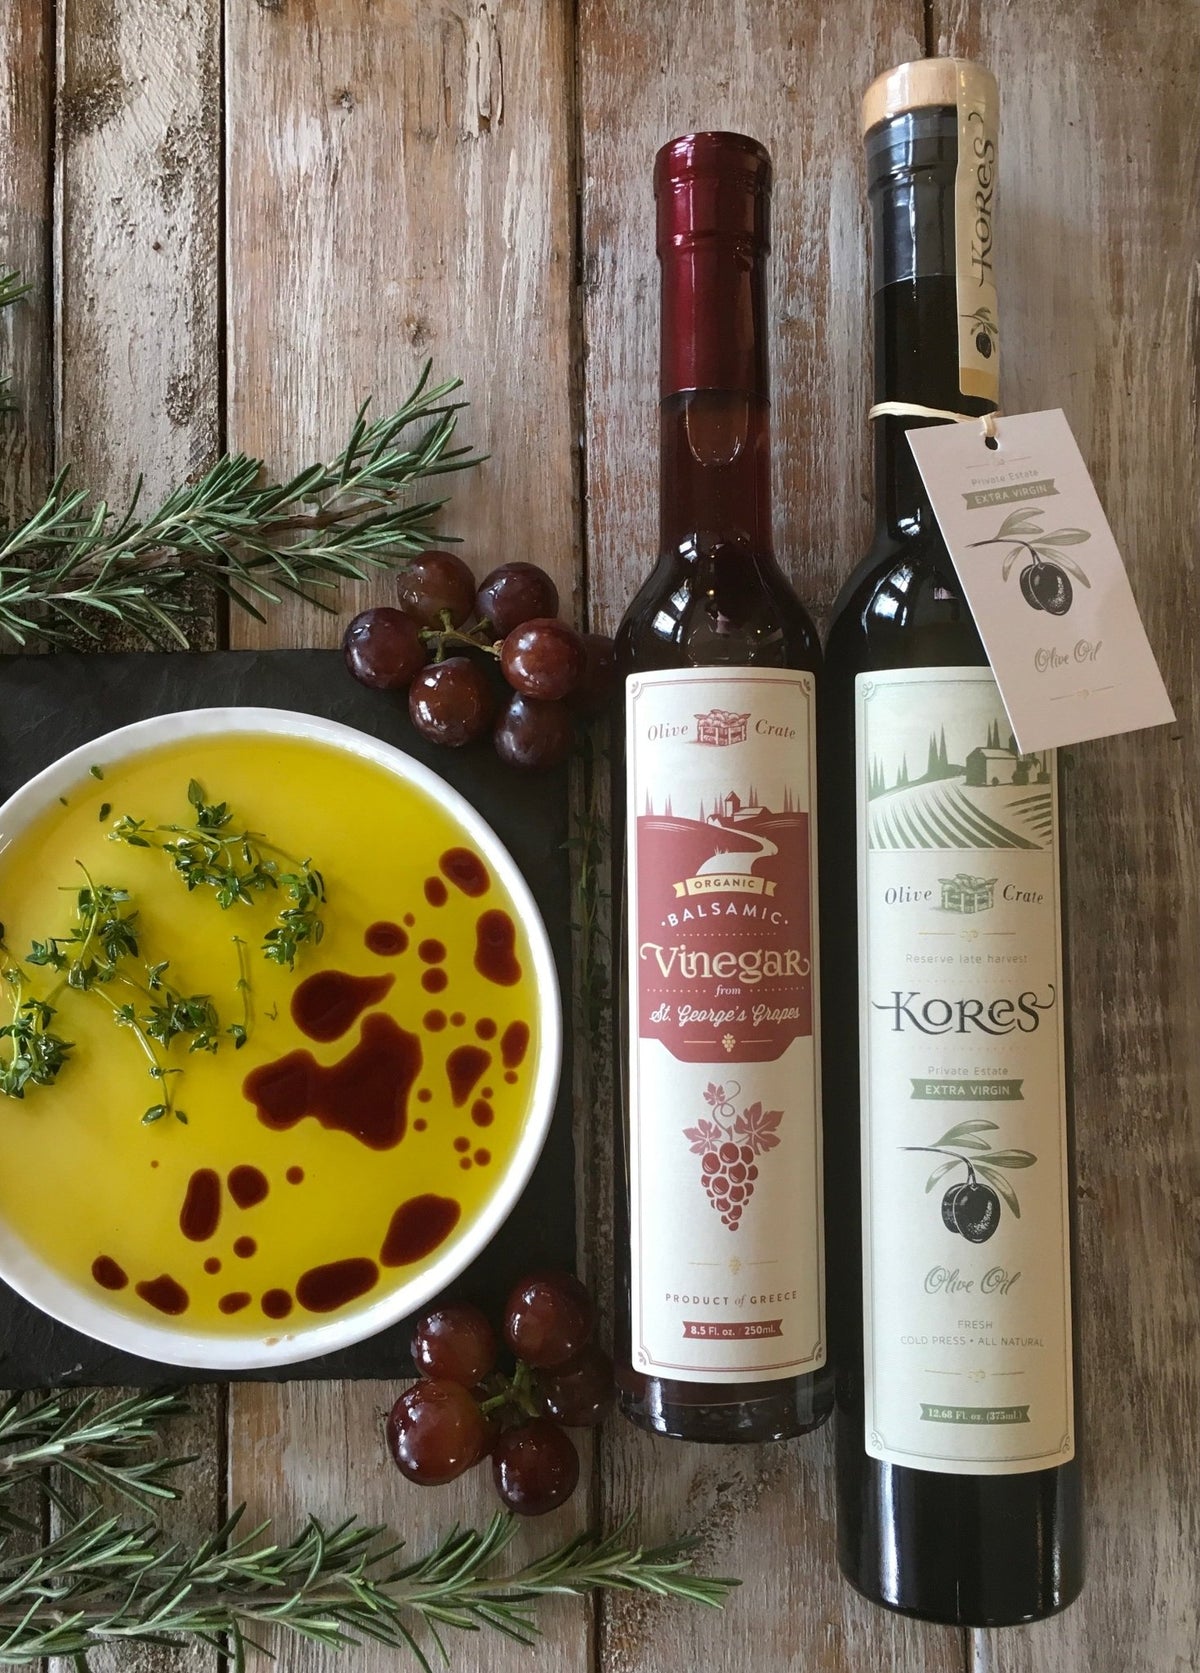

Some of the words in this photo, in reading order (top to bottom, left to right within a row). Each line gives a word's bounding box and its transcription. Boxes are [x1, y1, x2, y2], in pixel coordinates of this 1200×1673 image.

[971, 474, 1006, 487] Private
[1008, 468, 1039, 481] Estate
[974, 492, 1009, 505] EXTRA
[1012, 483, 1048, 498] VIRGIN
[1034, 647, 1070, 673] Olive
[1073, 638, 1102, 664] Oil
[647, 722, 689, 741] Olive
[755, 718, 796, 740] Crate
[693, 878, 756, 890] ORGANIC
[884, 886, 933, 905] Olive
[1002, 883, 1045, 905] Crate
[905, 953, 954, 964] Reserve
[959, 953, 982, 964] late
[986, 953, 1028, 964] harvest
[714, 984, 741, 997] from
[649, 1002, 672, 1024] St.
[677, 1003, 748, 1028] George's
[751, 1003, 801, 1027] Grapes
[927, 1065, 969, 1076] Private
[973, 1065, 1009, 1076] Estate
[925, 1084, 966, 1096] EXTRA
[970, 1084, 1010, 1096] VIRGIN
[924, 1265, 974, 1295] Olive
[980, 1265, 1022, 1296] Oil
[665, 1293, 729, 1306] PRODUCT
[735, 1294, 747, 1308] of
[750, 1290, 798, 1305] GREECE
[690, 1325, 707, 1336] 8.5
[708, 1326, 720, 1337] Fl.
[722, 1328, 736, 1336] oz.
[957, 1320, 993, 1330] FRESH
[900, 1335, 928, 1346] COLD
[932, 1335, 966, 1346] PRESS
[977, 1336, 997, 1347] ALL
[1000, 1336, 1045, 1348] NATURAL
[927, 1407, 953, 1420] 12.68
